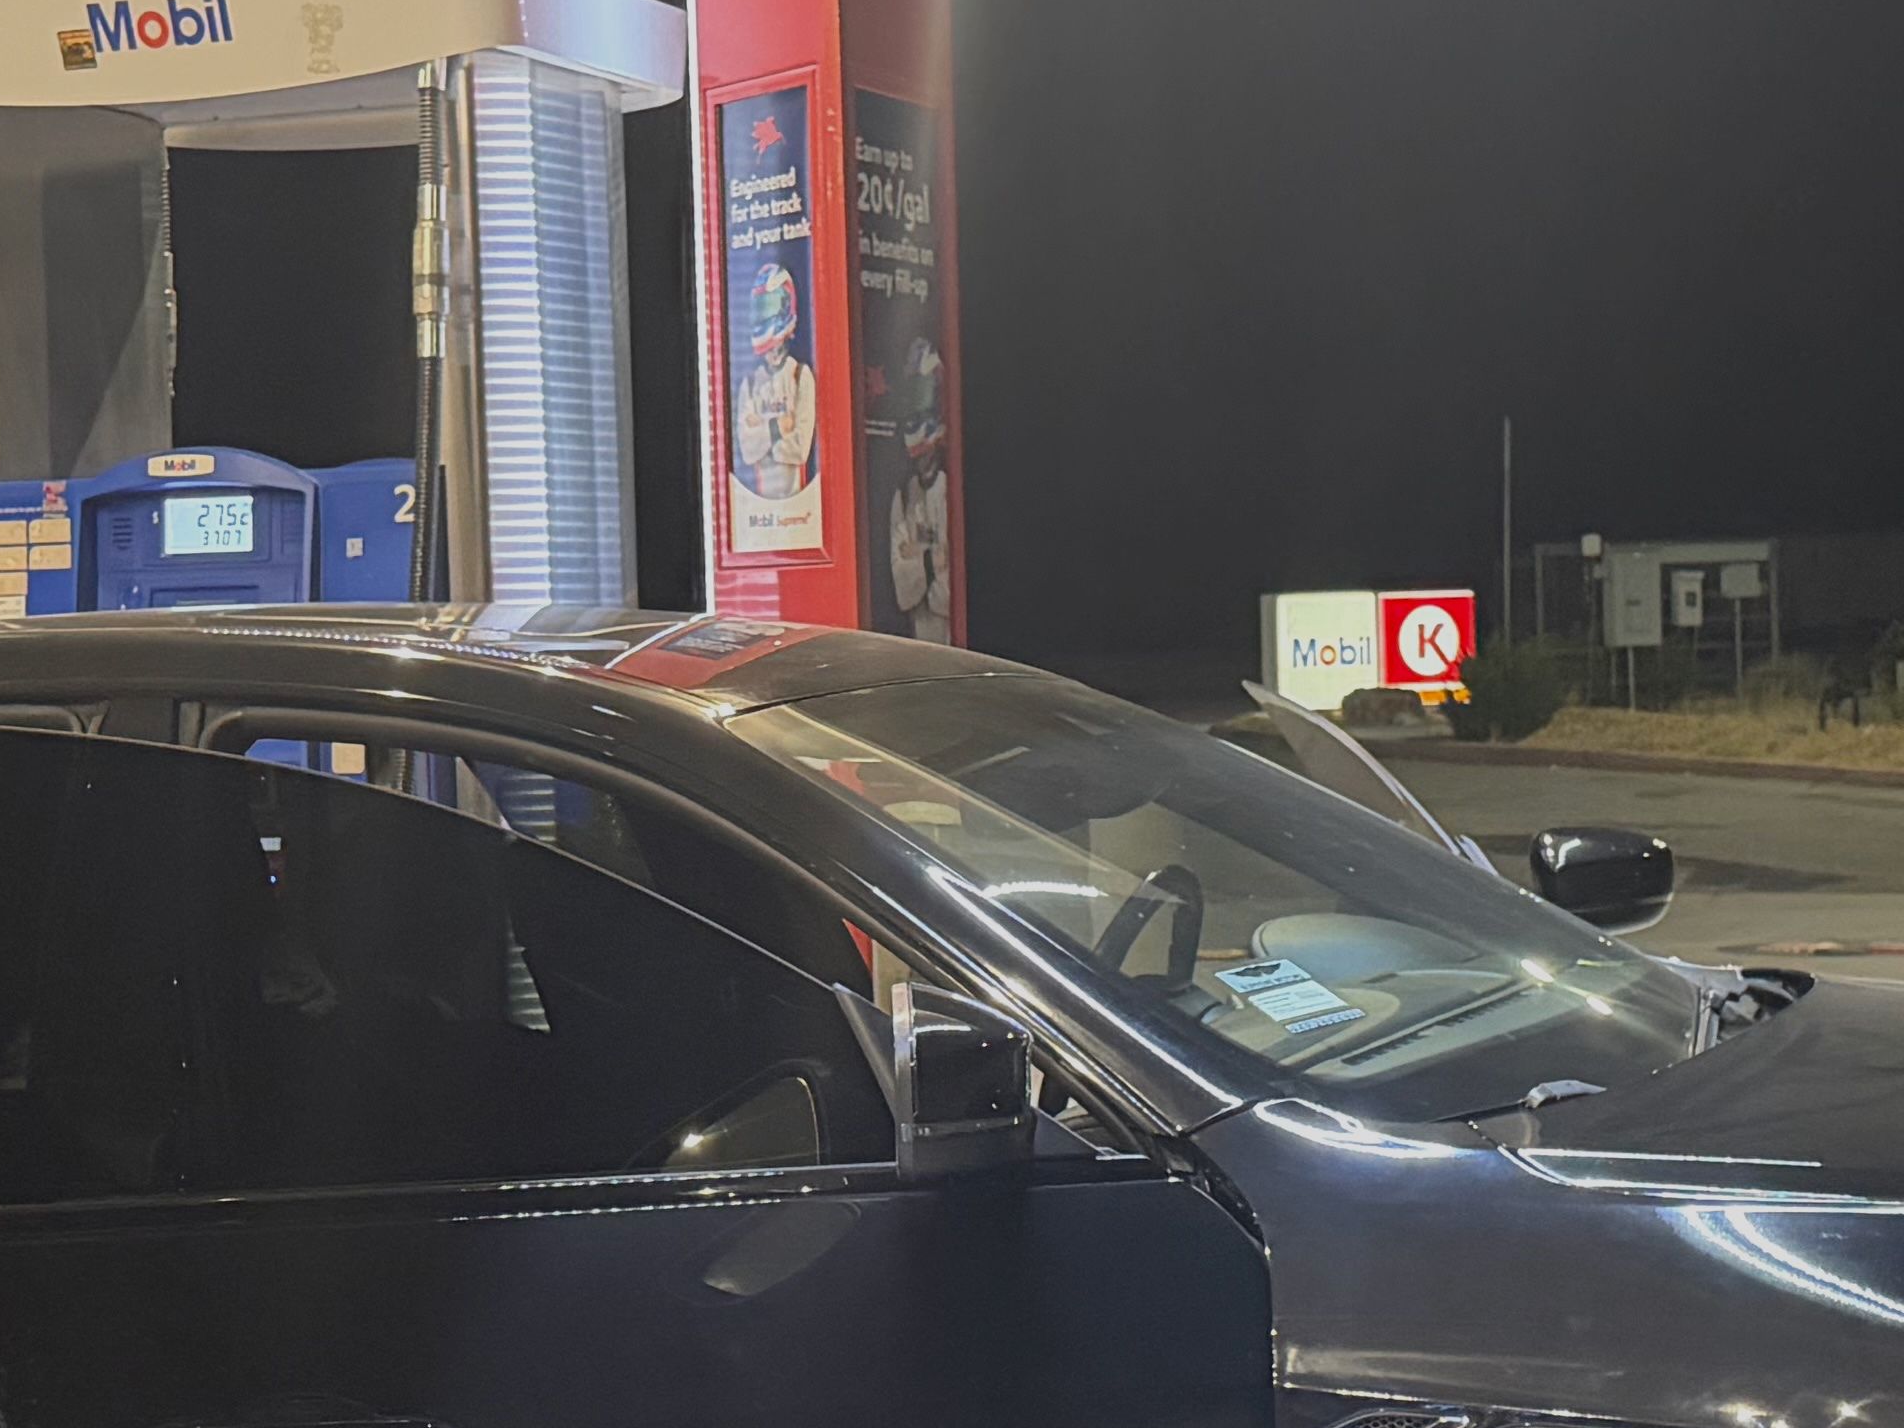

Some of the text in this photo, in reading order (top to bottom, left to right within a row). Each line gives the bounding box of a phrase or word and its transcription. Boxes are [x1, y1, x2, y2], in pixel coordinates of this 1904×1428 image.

[855, 136, 913, 173] Earn up to
[730, 166, 796, 201] Engineered
[731, 191, 802, 223] for the track
[857, 172, 930, 232] 20¢/gal
[731, 217, 812, 251] and your tank
[858, 229, 871, 255] in
[872, 232, 920, 264] benefits
[860, 270, 894, 299] every
[164, 460, 196, 472] Mobil
[393, 483, 417, 523] 2
[1292, 623, 1456, 668] Mobil K
